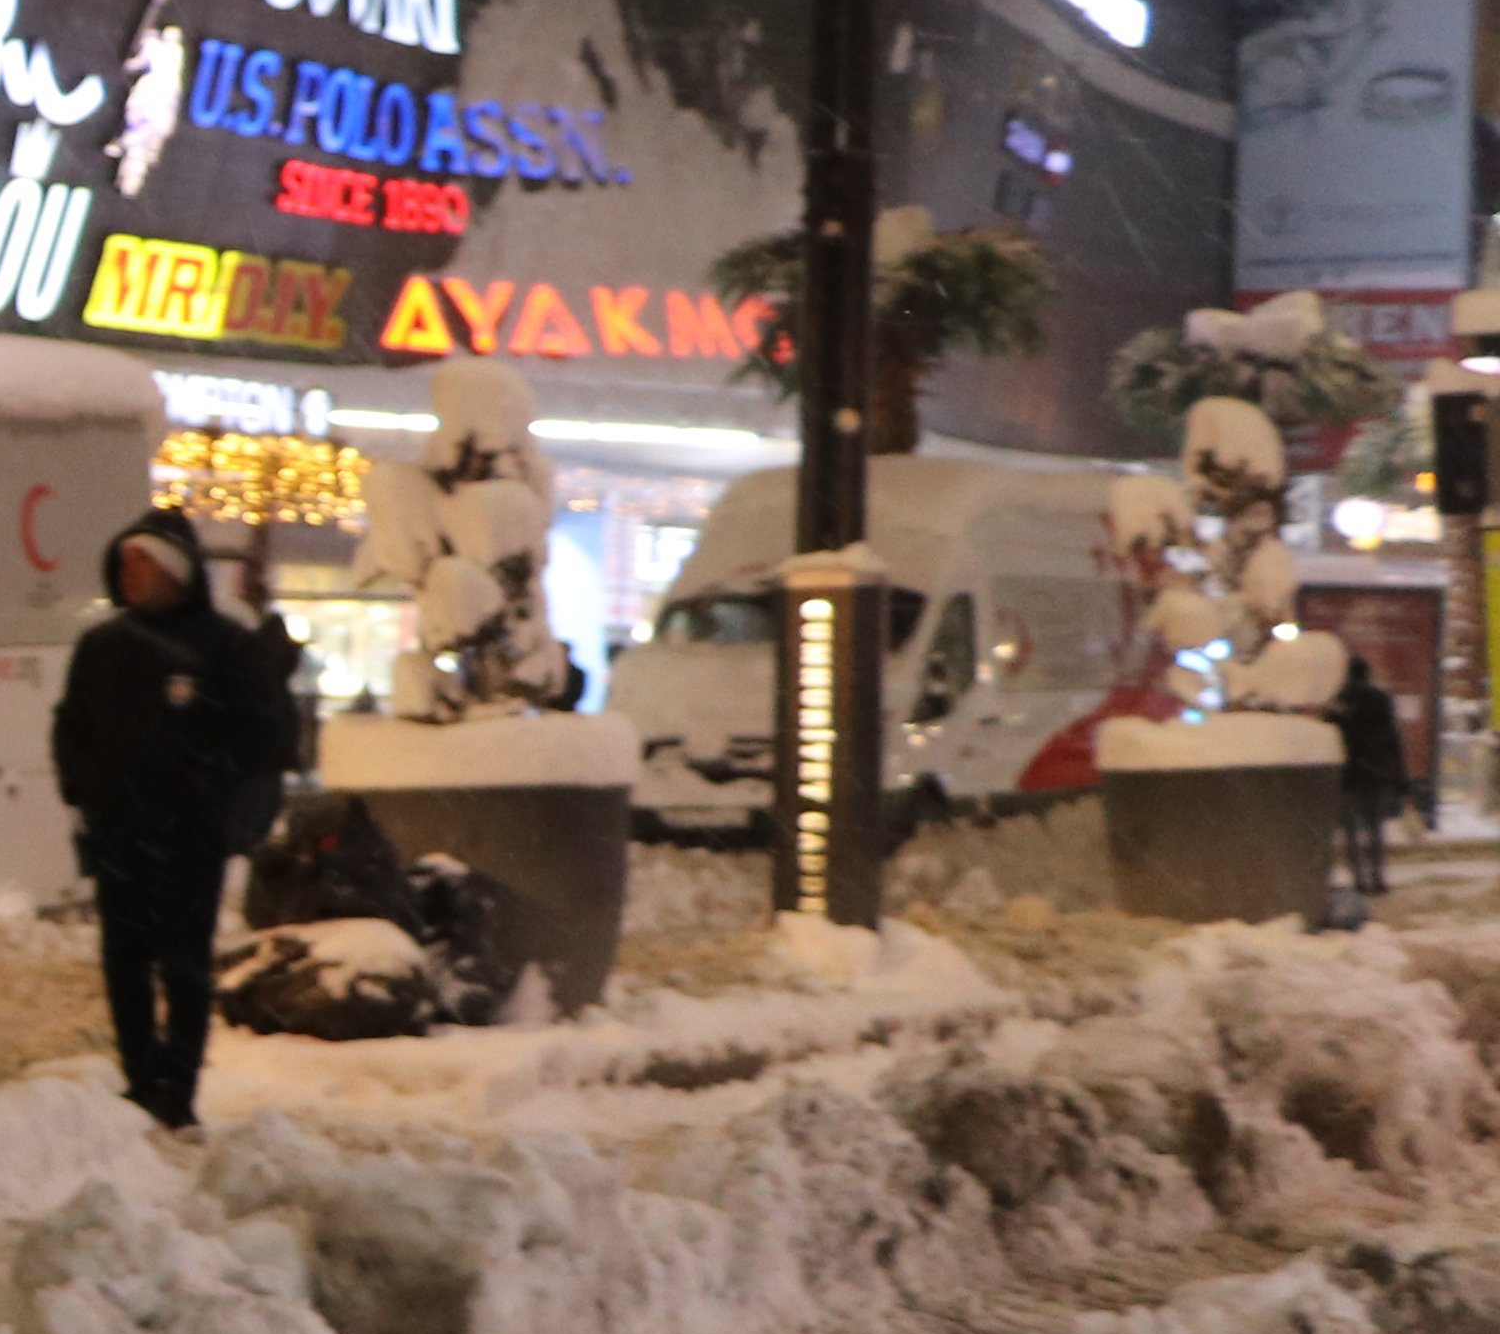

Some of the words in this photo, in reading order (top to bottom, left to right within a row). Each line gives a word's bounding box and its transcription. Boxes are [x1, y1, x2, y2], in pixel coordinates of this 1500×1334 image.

[188, 38, 285, 138] U.S.
[284, 60, 417, 166] POLO
[420, 91, 633, 186] ASSN.
[378, 274, 796, 365] AYAKMO
